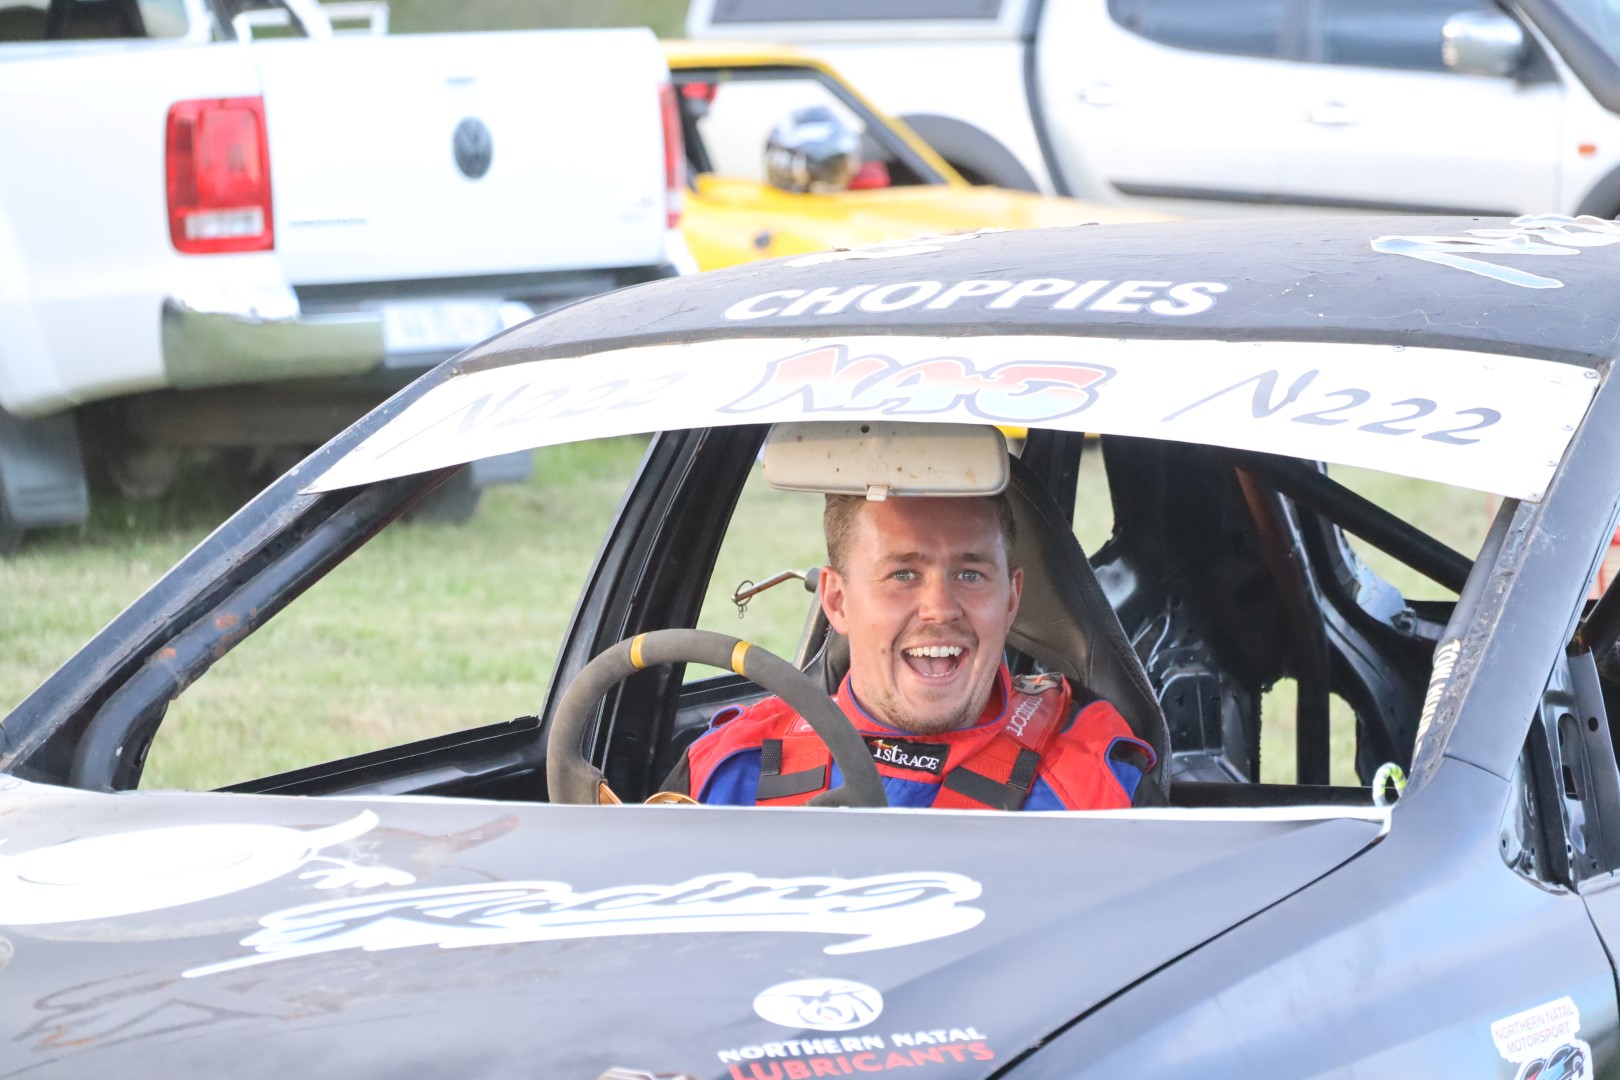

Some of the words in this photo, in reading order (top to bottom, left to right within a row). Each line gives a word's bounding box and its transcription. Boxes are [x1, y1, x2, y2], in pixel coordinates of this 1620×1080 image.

[720, 278, 1229, 323] CHOPPIES
[1160, 369, 1502, 446] N222
[1494, 1014, 1546, 1041] NORTHERN
[1545, 1003, 1574, 1022] NATAL
[1506, 1020, 1571, 1056] MOTORSPORT
[717, 1034, 885, 1064] NORTHERN
[890, 1026, 988, 1048] NATAL
[727, 1041, 996, 1080] LUBRICANTS
